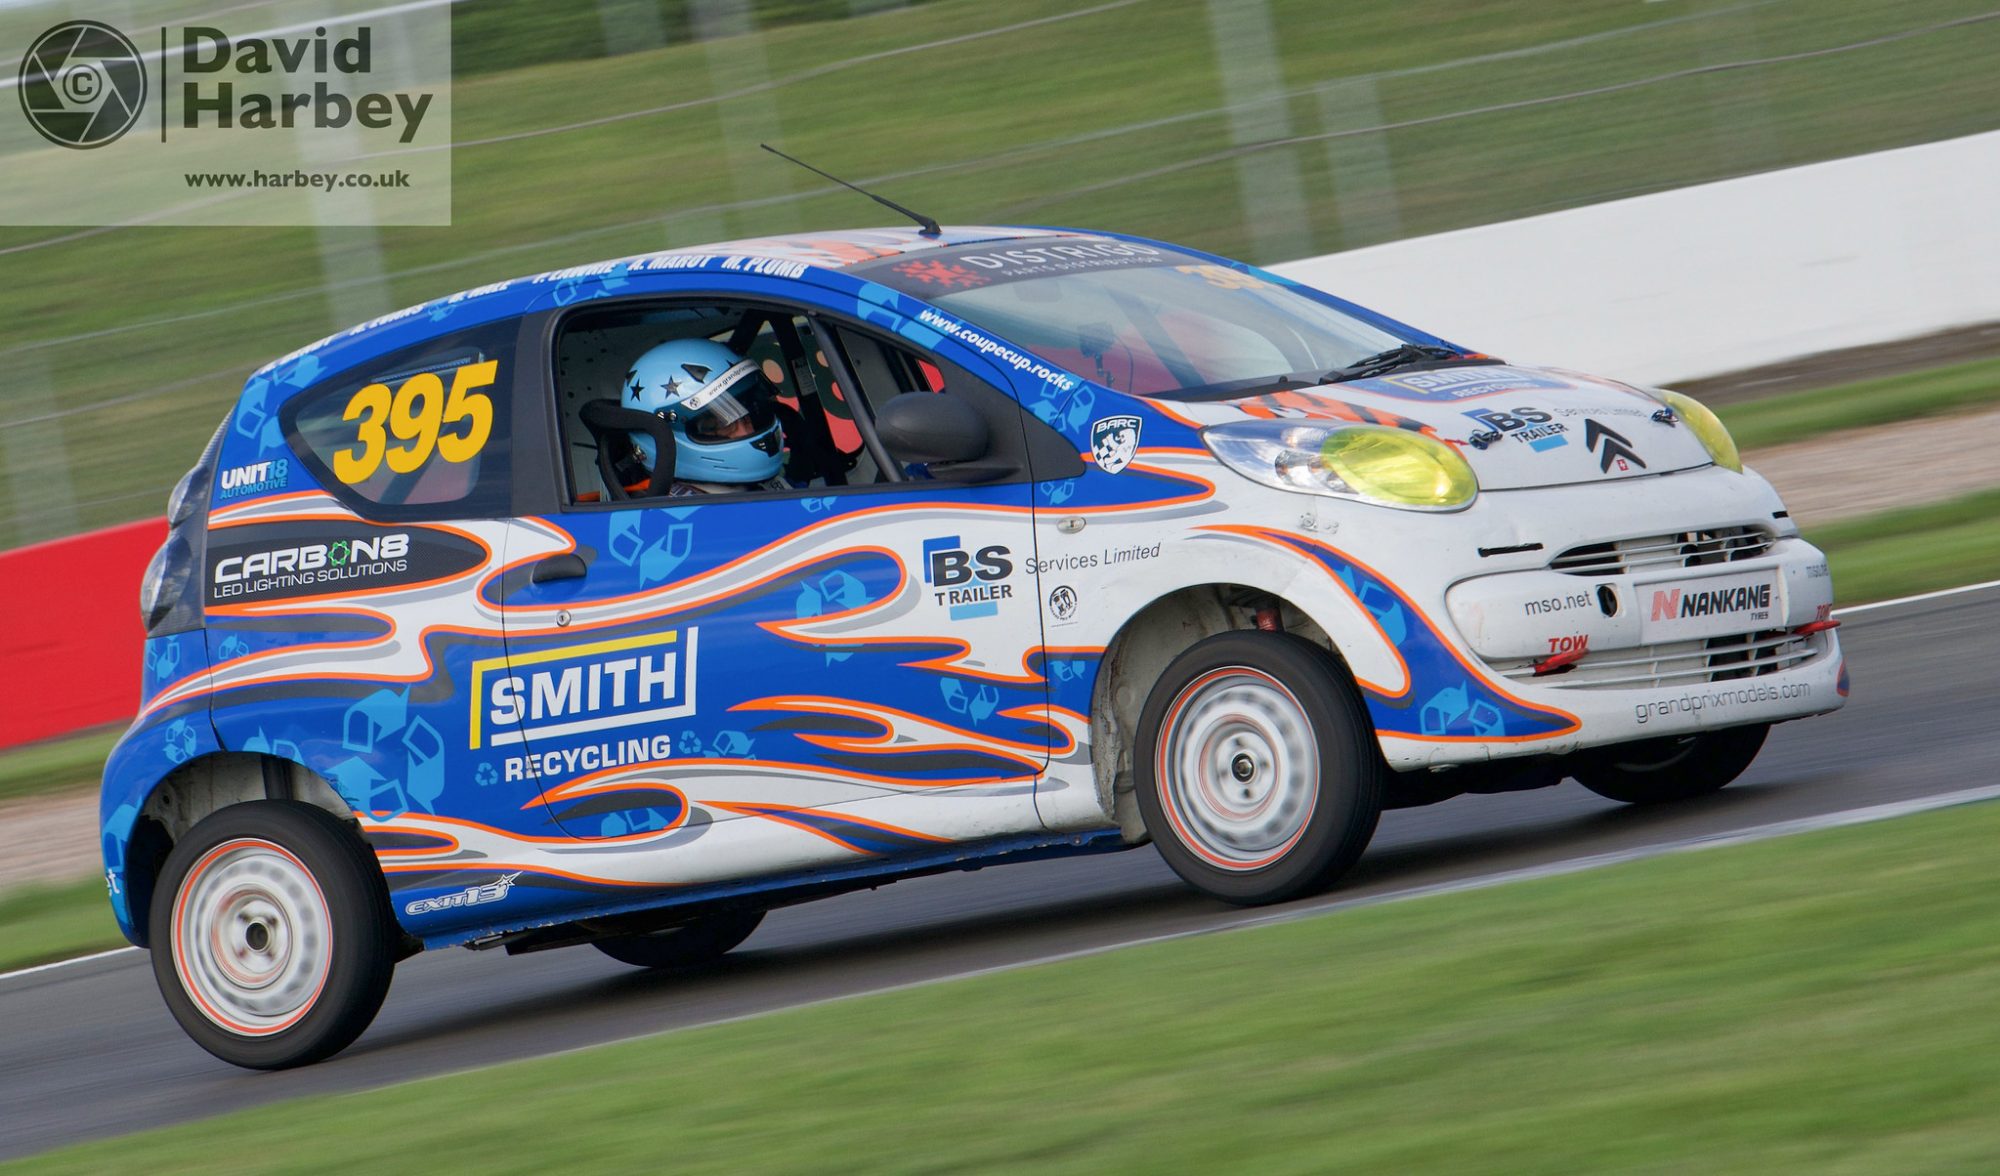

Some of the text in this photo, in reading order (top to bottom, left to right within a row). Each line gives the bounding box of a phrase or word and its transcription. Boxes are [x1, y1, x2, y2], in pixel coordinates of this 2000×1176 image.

[647, 255, 717, 270] MAROT
[744, 257, 810, 279] PLUMB
[960, 243, 1160, 269] DISTRIGO
[919, 309, 1074, 391] www.coupecup.rocks
[334, 360, 498, 484] 395
[1096, 419, 1137, 433] BARC
[1510, 423, 1569, 444] TRAILER
[220, 477, 288, 499] AUTOMOTIVE
[221, 459, 288, 489] UNIT18
[1025, 554, 1098, 574] Services
[1104, 542, 1161, 565] Limited
[214, 559, 408, 599] LED LIGHTING SOLUTIONS
[1525, 591, 1593, 616] mso.net
[1681, 584, 1771, 618] NANKANG
[1548, 634, 1589, 653] TOW
[491, 652, 676, 725] SMITH
[1636, 682, 1811, 724] grandprixmodels.com
[505, 735, 671, 782] RECYCLING
